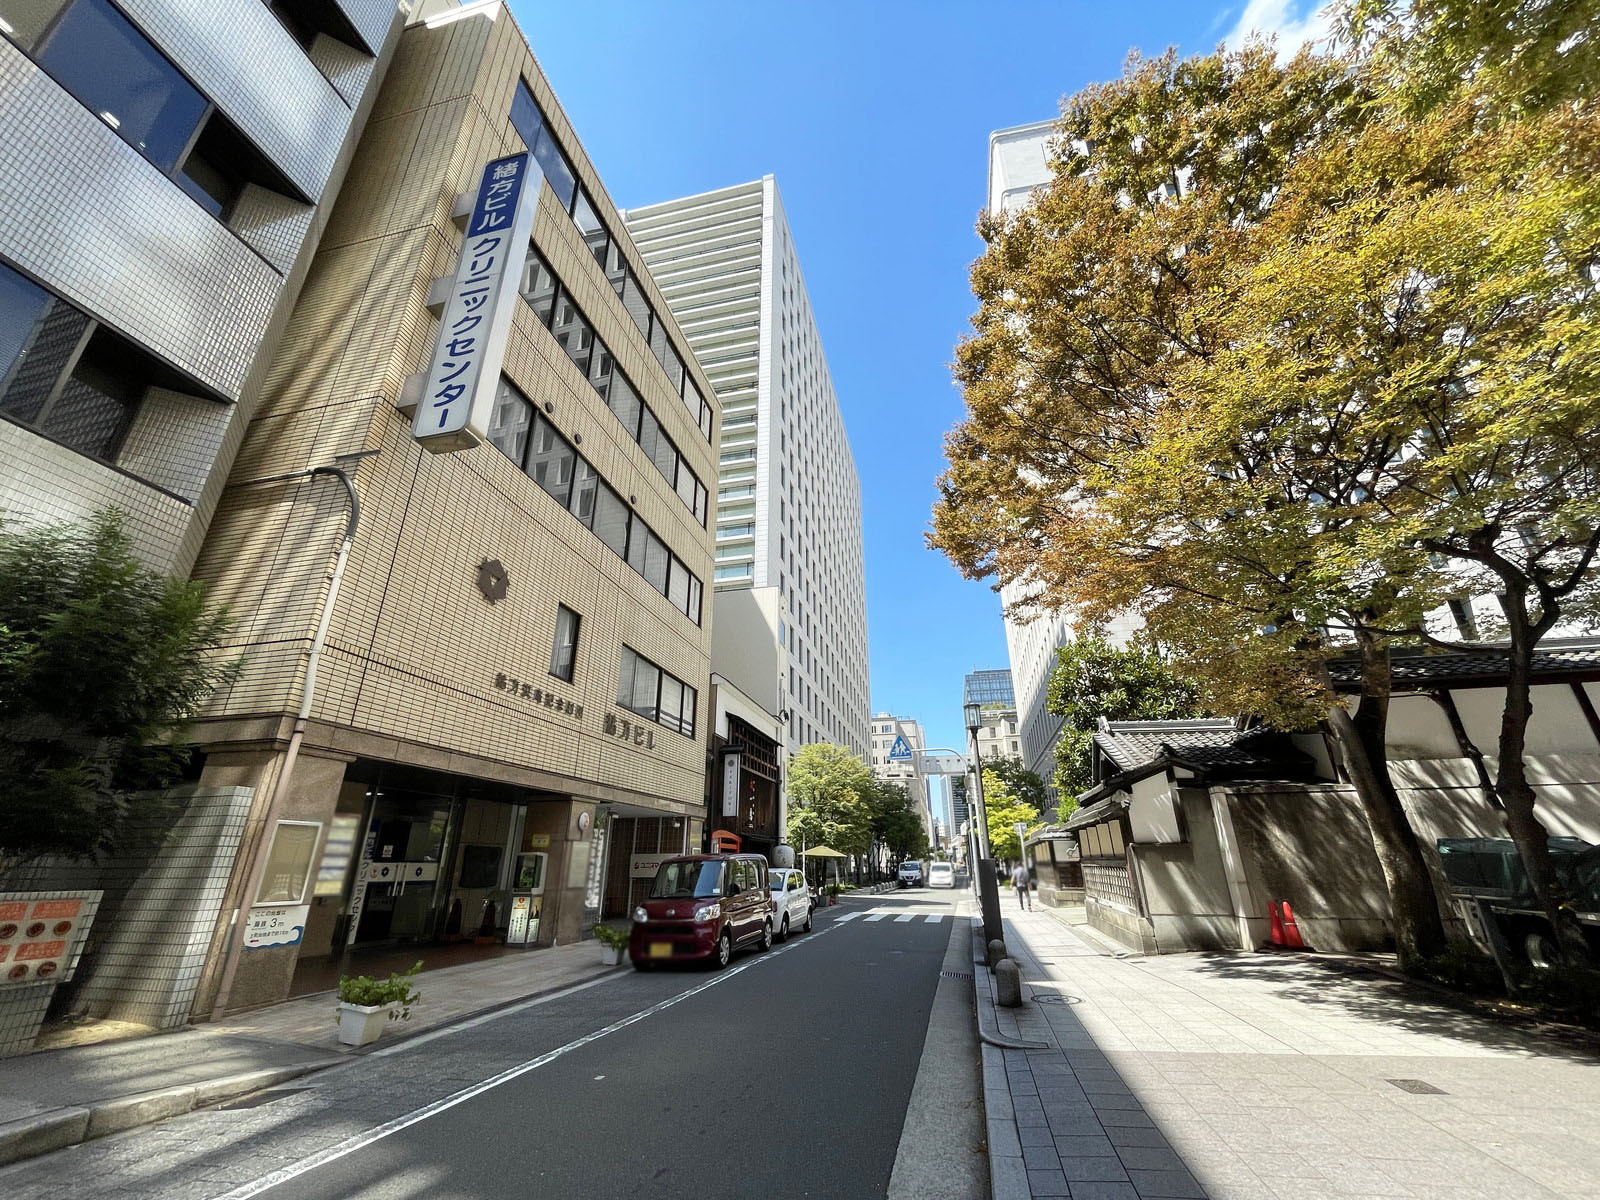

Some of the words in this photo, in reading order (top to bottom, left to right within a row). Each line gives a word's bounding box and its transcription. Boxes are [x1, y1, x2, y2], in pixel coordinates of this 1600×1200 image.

[477, 160, 520, 231] 緒方ビル
[434, 236, 501, 428] クリニックセンター
